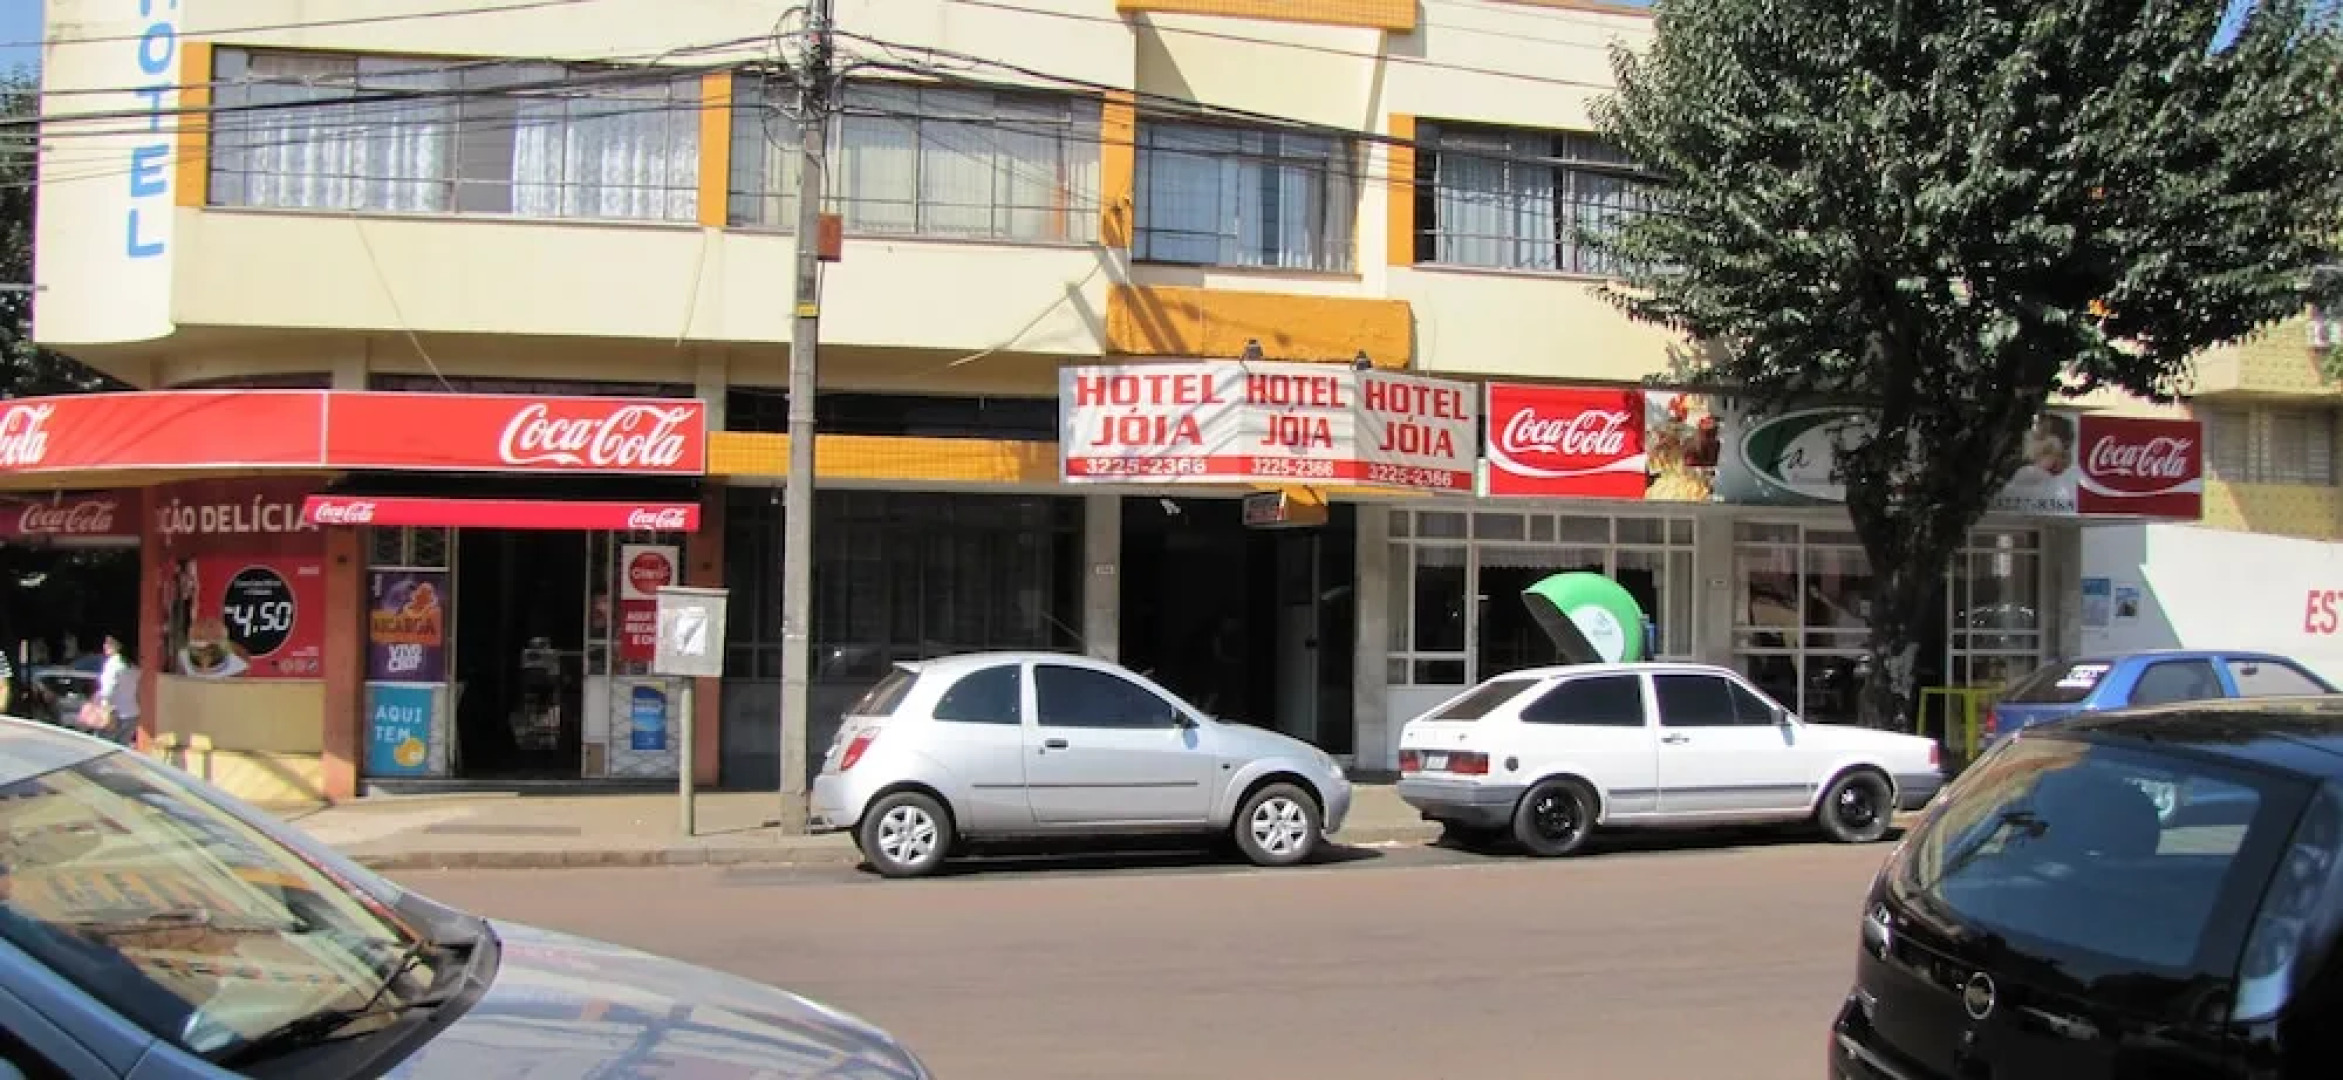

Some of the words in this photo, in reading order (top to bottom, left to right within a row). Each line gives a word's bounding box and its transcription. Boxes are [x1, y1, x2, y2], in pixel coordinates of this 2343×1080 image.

[127, 0, 177, 258] OTEL
[1077, 374, 1226, 406] HOTEL
[1246, 374, 1346, 408] HOTEL
[1365, 379, 1469, 420] HOTEL
[499, 403, 697, 466] Coca-Cola
[1090, 407, 1203, 447] JÓIA
[1260, 407, 1333, 448] JÓIA
[1380, 414, 1455, 458] JÓIA
[1502, 407, 1631, 455] Coca-Cola
[2089, 435, 2193, 477] Coca-Cola
[19, 501, 118, 534] Coca-Cola
[315, 501, 376, 523] Coca-Cola
[628, 507, 687, 529] Coca-Cola
[375, 704, 422, 723] AQUI
[375, 726, 411, 742] TEM
